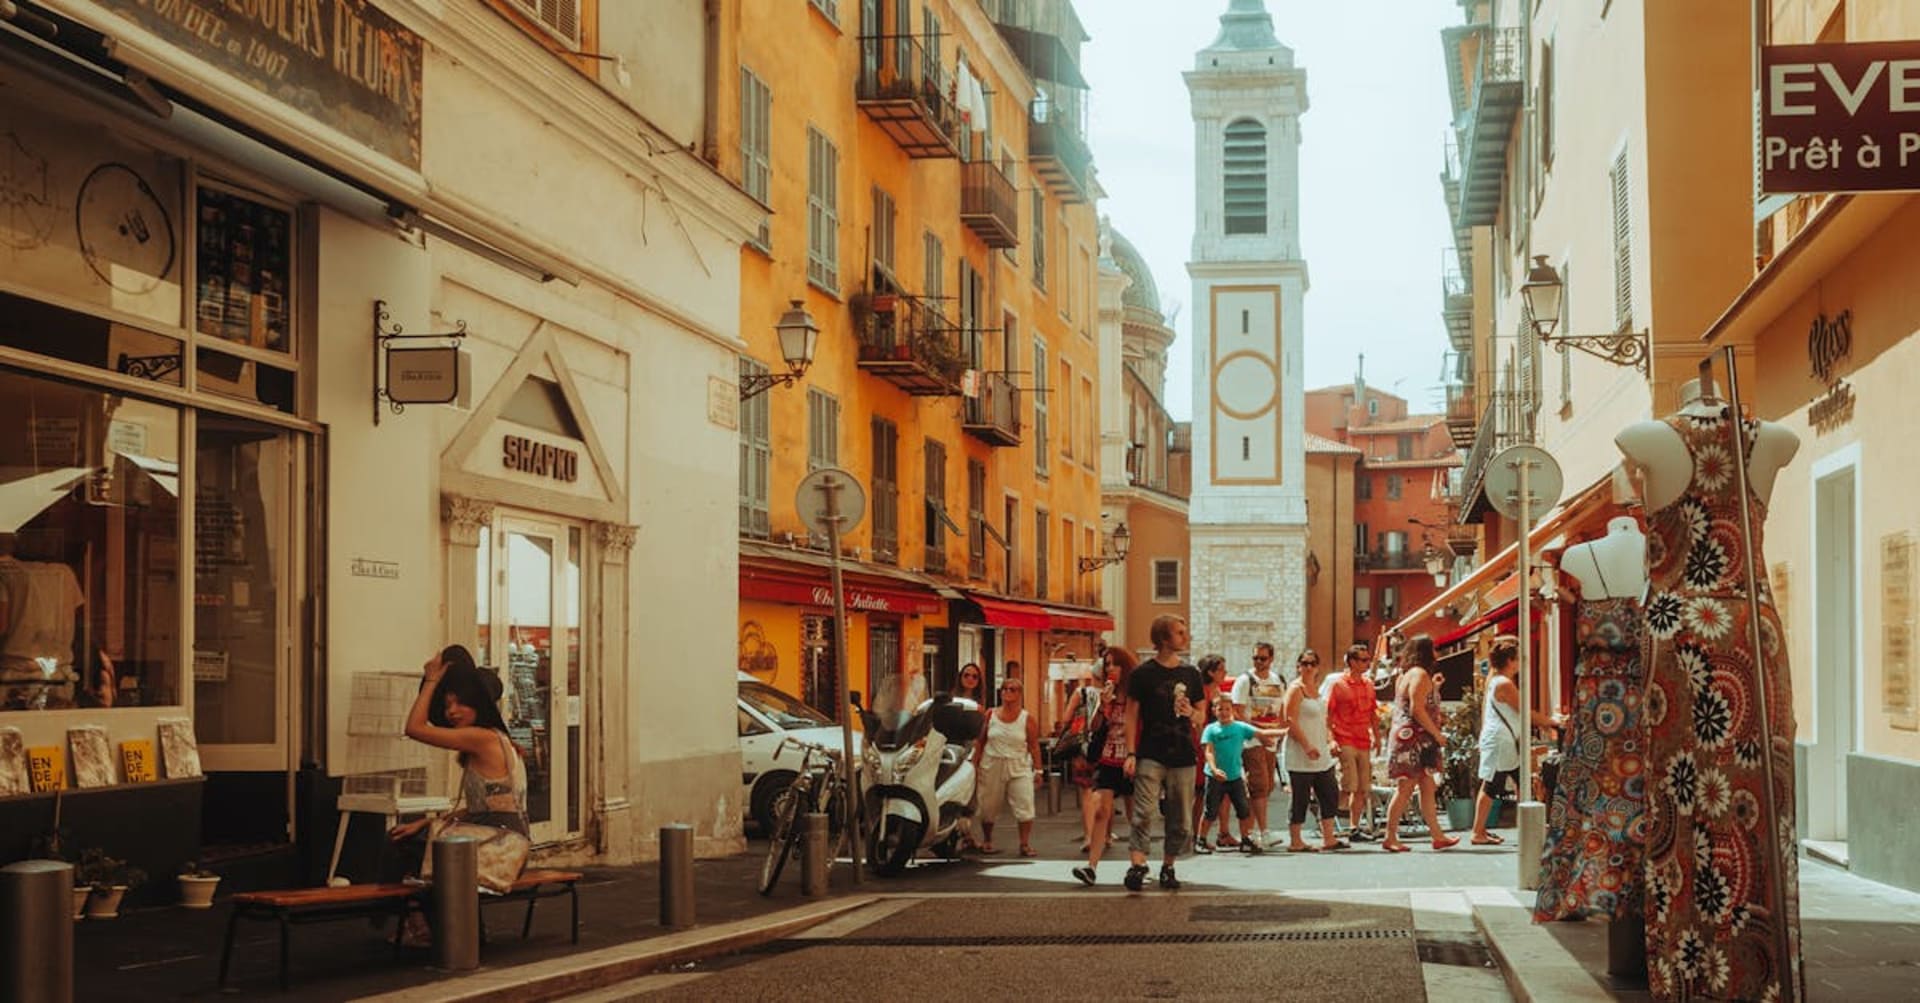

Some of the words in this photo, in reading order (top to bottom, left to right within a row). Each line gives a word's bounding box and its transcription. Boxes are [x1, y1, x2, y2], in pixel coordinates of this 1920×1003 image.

[246, 37, 289, 80] 1907
[1765, 135, 1843, 171] Prêt
[1856, 134, 1881, 168] à
[503, 434, 578, 483] SHAPKO
[127, 750, 143, 762] EN
[32, 757, 51, 769] EN
[127, 762, 143, 773] DE
[34, 770, 51, 782] DE
